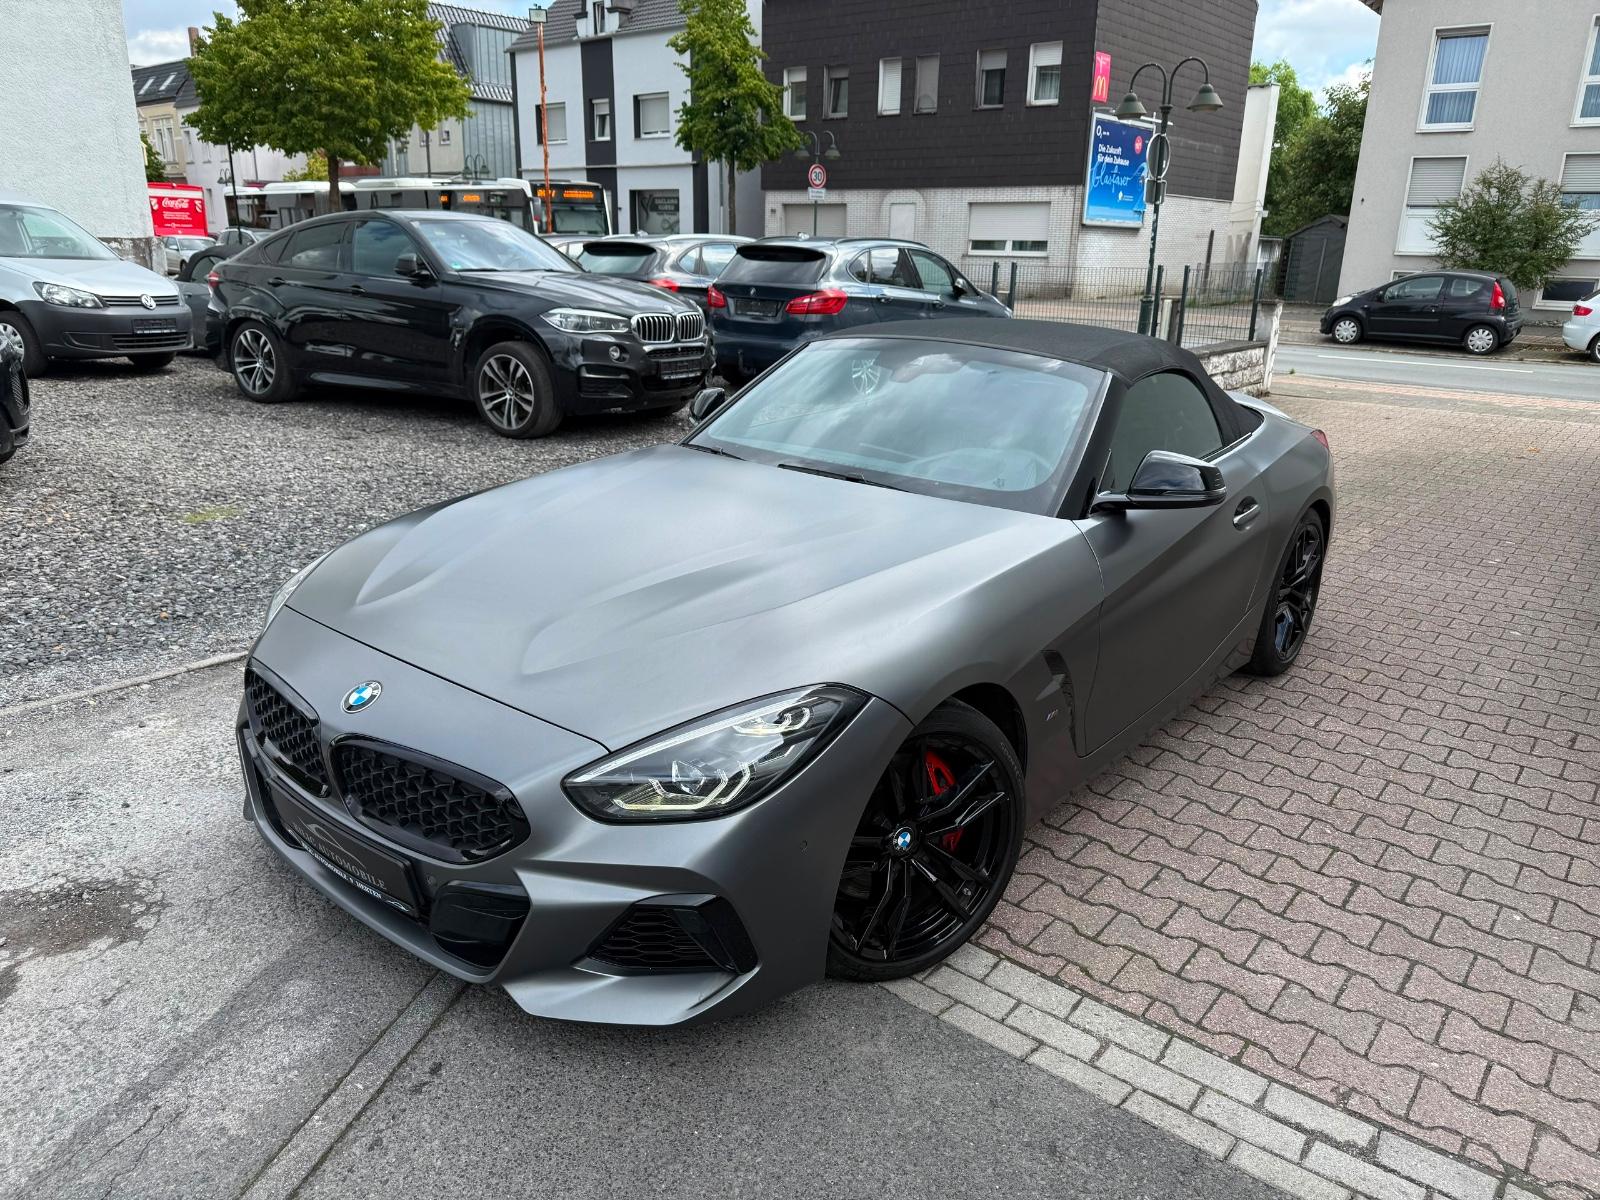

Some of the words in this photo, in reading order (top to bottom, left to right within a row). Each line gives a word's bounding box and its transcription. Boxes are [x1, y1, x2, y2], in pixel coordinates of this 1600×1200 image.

[1098, 143, 1106, 152] Die
[1106, 144, 1122, 155] Zukunft
[812, 171, 822, 181] 30
